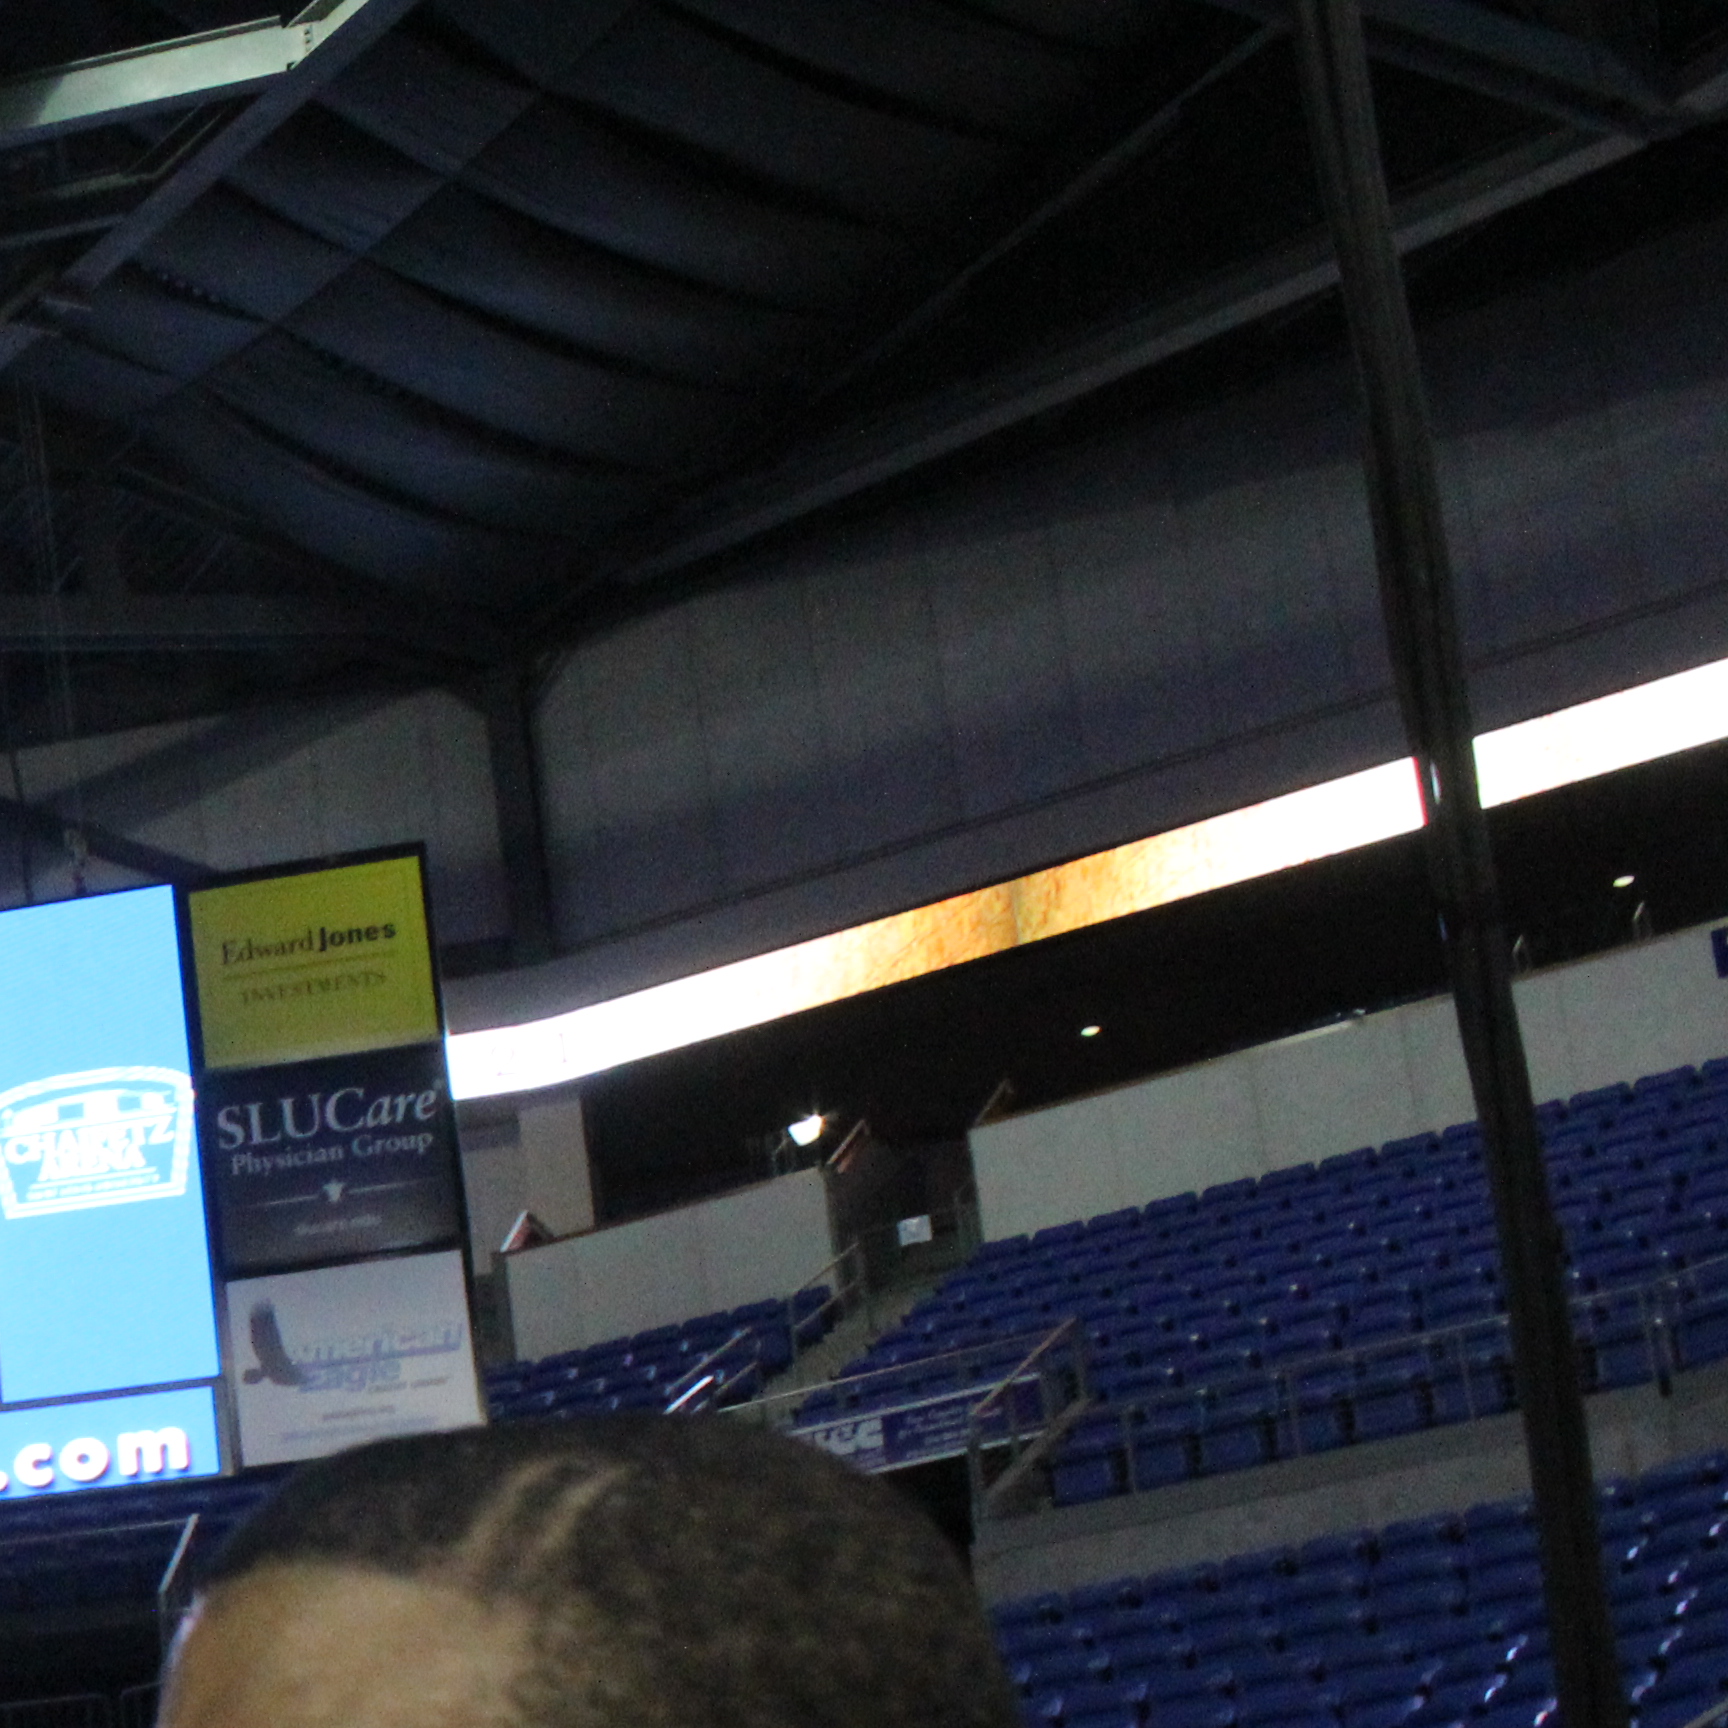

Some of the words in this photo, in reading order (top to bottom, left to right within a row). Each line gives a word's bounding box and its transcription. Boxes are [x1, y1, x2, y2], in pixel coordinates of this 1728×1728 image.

[217, 1087, 437, 1150] SLUCare
[231, 1143, 343, 1176] Physician
[350, 1132, 434, 1158] Group
